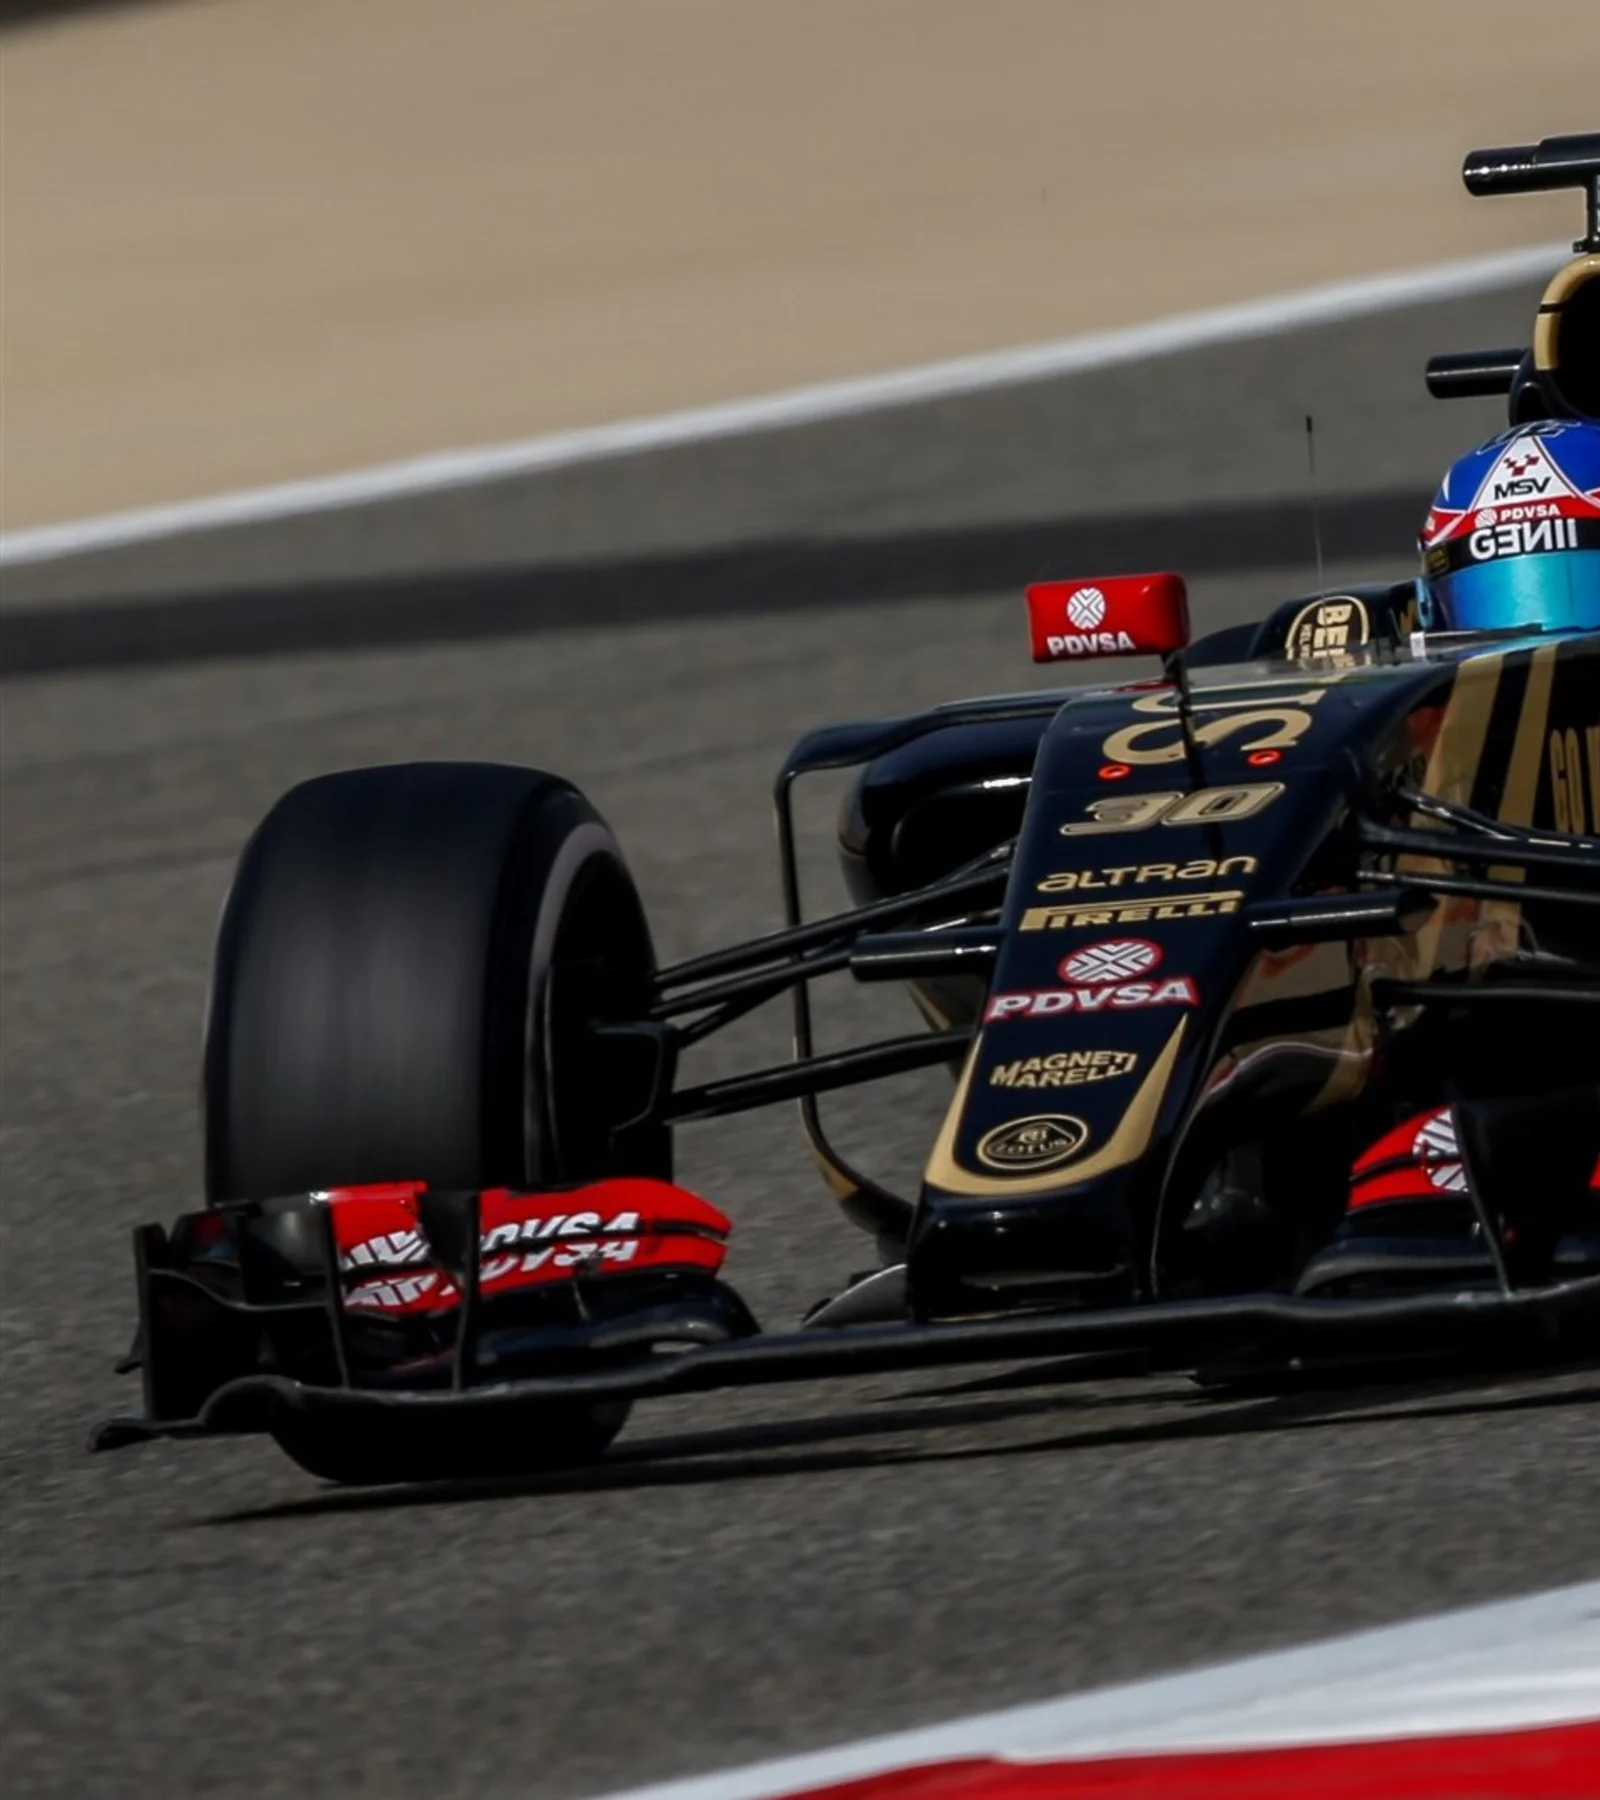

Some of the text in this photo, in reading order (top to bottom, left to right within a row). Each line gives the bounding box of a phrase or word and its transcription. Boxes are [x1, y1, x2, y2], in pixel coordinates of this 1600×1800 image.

[1494, 477, 1551, 500] MSV
[1500, 504, 1561, 522] PDVSA
[1047, 631, 1136, 656] PDVSA
[1550, 727, 1586, 836] GO
[1059, 782, 1286, 836] 30
[1018, 889, 1245, 932] PIRELLI
[985, 977, 1196, 1021] PDVSA
